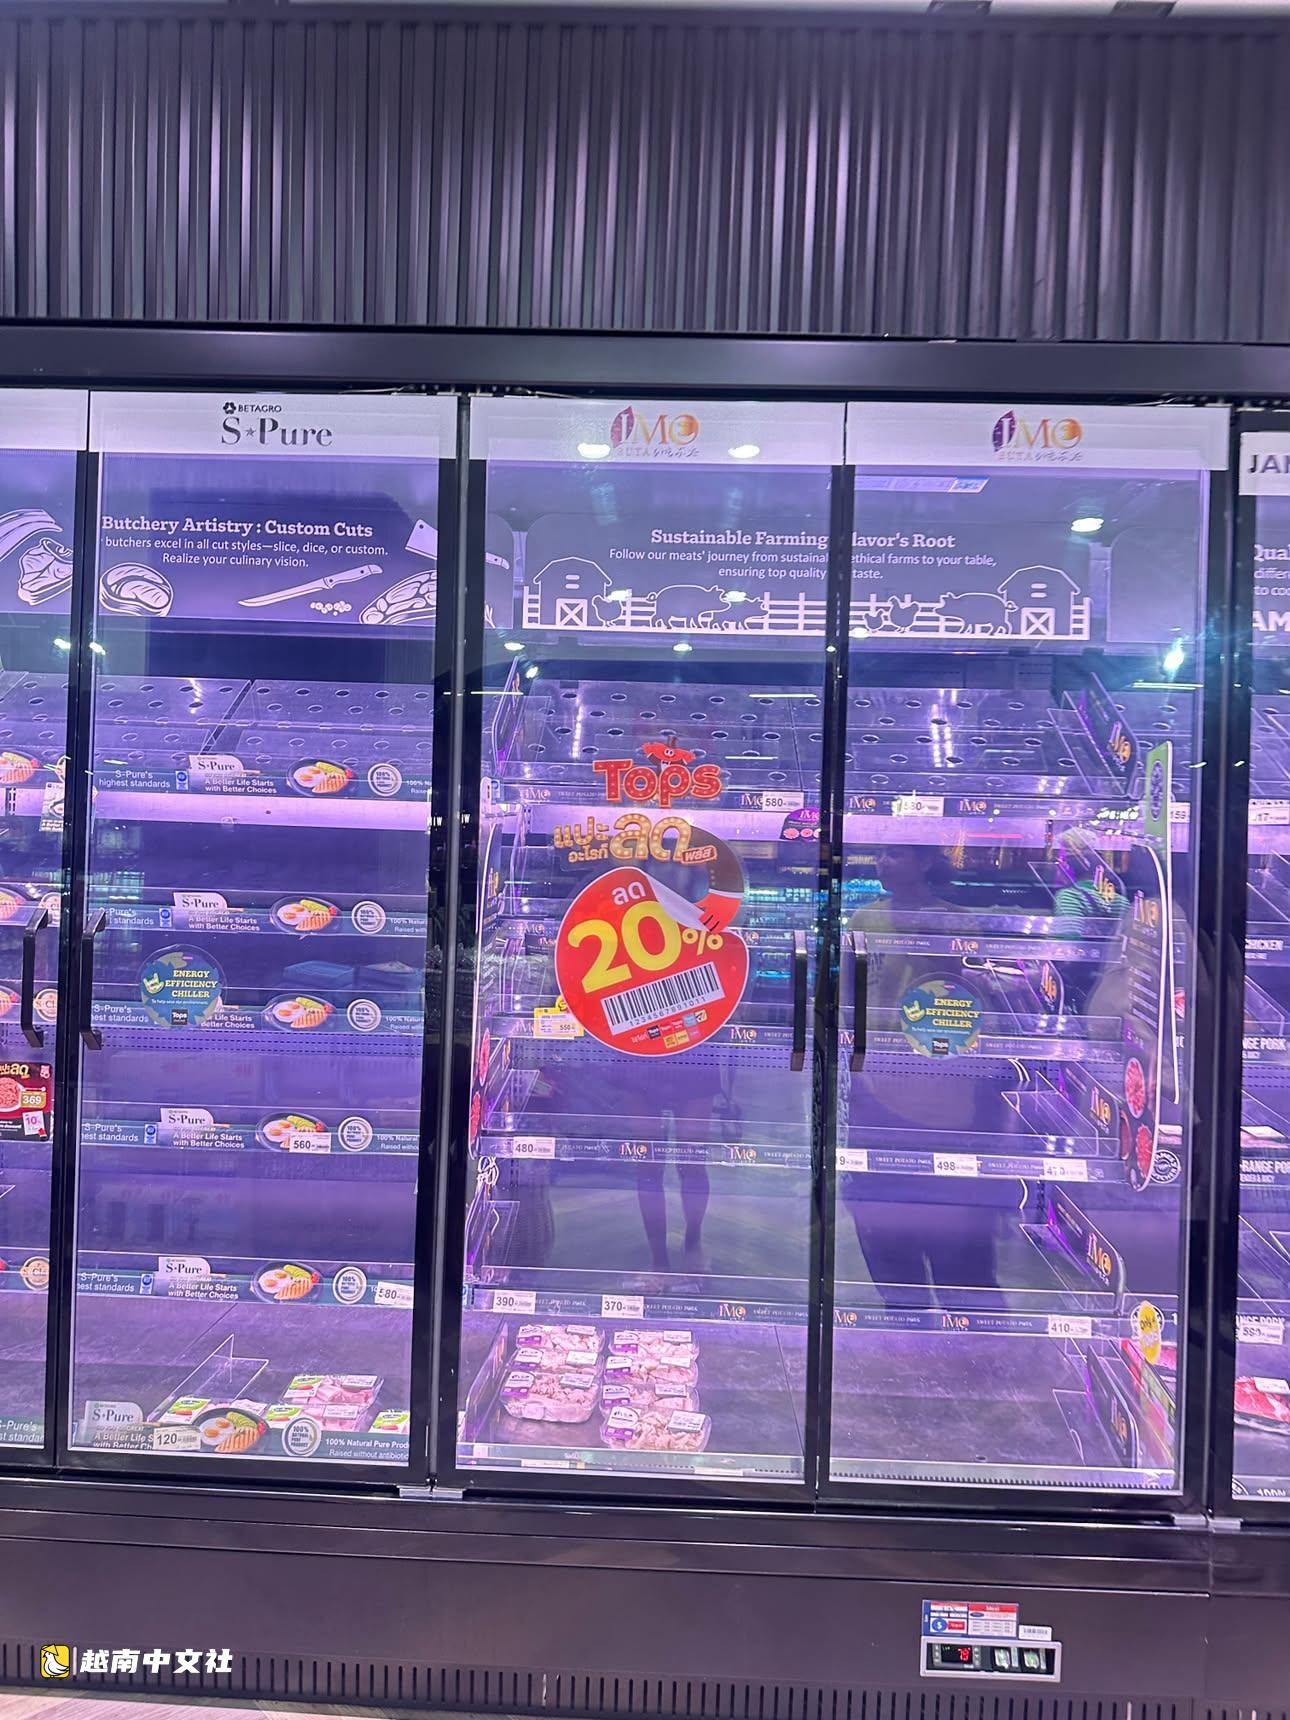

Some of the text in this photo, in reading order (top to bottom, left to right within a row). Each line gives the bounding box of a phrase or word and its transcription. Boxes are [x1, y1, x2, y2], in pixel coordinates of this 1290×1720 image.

[238, 404, 282, 413] BETAGRO
[102, 516, 179, 534] Butchery
[182, 517, 253, 536] Artistry
[265, 520, 330, 535] Custom
[334, 522, 373, 537] Cuts
[651, 529, 956, 550] Sustainable Farming lavor's Root
[105, 536, 152, 548] butchers
[154, 538, 181, 549] excel
[184, 538, 194, 549] in
[197, 539, 209, 549] all
[212, 540, 229, 550] cut
[302, 542, 328, 555] dice,
[331, 545, 343, 553] or
[345, 545, 389, 556] custom.
[162, 552, 309, 568] Realize your culinary vision.
[609, 548, 645, 560] Follow
[647, 551, 667, 561] our
[669, 551, 705, 562] meats'
[707, 553, 754, 563] journey
[751, 552, 778, 563] from
[887, 553, 920, 565] farms
[922, 555, 934, 565] to
[936, 557, 962, 567] your
[965, 555, 998, 567] table,
[718, 567, 765, 579] ensuring
[768, 567, 787, 579] top
[789, 567, 827, 579] quality
[115, 769, 153, 780] S-Pure's
[99, 778, 171, 788] highest standards
[592, 759, 722, 808] Tops
[554, 813, 692, 862] แปะ ลด
[612, 880, 647, 906] ลด
[115, 917, 154, 925] standards
[173, 970, 209, 978] ENERGY
[165, 980, 218, 988] EFFICIENCY
[172, 990, 210, 998] CHILLER
[934, 999, 973, 1008] ENERGY
[94, 1005, 131, 1014] S-Pure's
[926, 1008, 980, 1018] EFFICIENCY
[109, 1014, 149, 1023] standards
[230, 1014, 252, 1022] Starts
[932, 1019, 973, 1028] CHILLER
[23, 1096, 41, 1105] 369
[85, 1123, 122, 1132] S-Pure's
[98, 1133, 138, 1142] standards
[81, 1273, 118, 1282] S-Pure's
[94, 1284, 134, 1292] standards
[130, 1434, 147, 1442] Life
[326, 1438, 345, 1446] 100%
[347, 1439, 373, 1447] Natural
[329, 1449, 352, 1457] Raised
[353, 1450, 378, 1459] without
